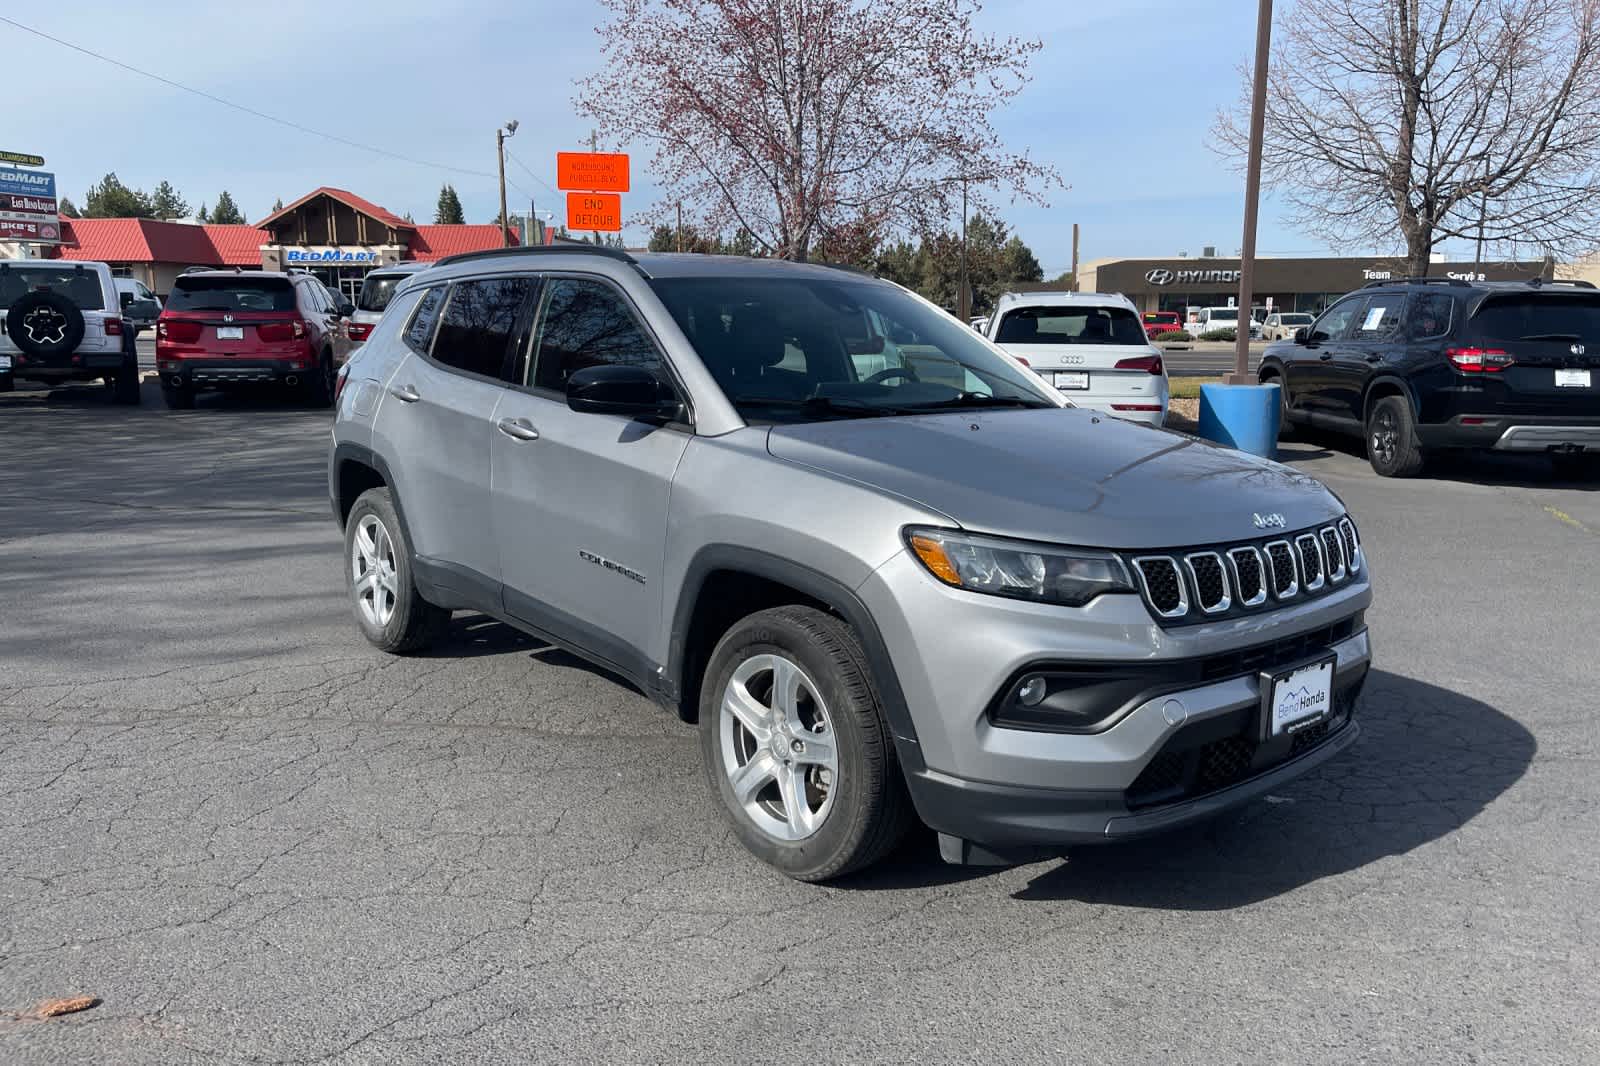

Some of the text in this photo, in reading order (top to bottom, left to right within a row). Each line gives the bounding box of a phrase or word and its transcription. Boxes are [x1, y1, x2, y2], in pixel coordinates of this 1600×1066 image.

[0, 173, 50, 185] EDMART
[584, 199, 604, 210] END
[575, 214, 613, 225] DETOUR
[1176, 270, 1242, 282] HYUNDA
[1362, 269, 1391, 280] Team
[1446, 271, 1486, 282] Servie
[1253, 512, 1287, 529] Jeep
[578, 550, 646, 585] COMPASS
[1300, 689, 1326, 711] Honda
